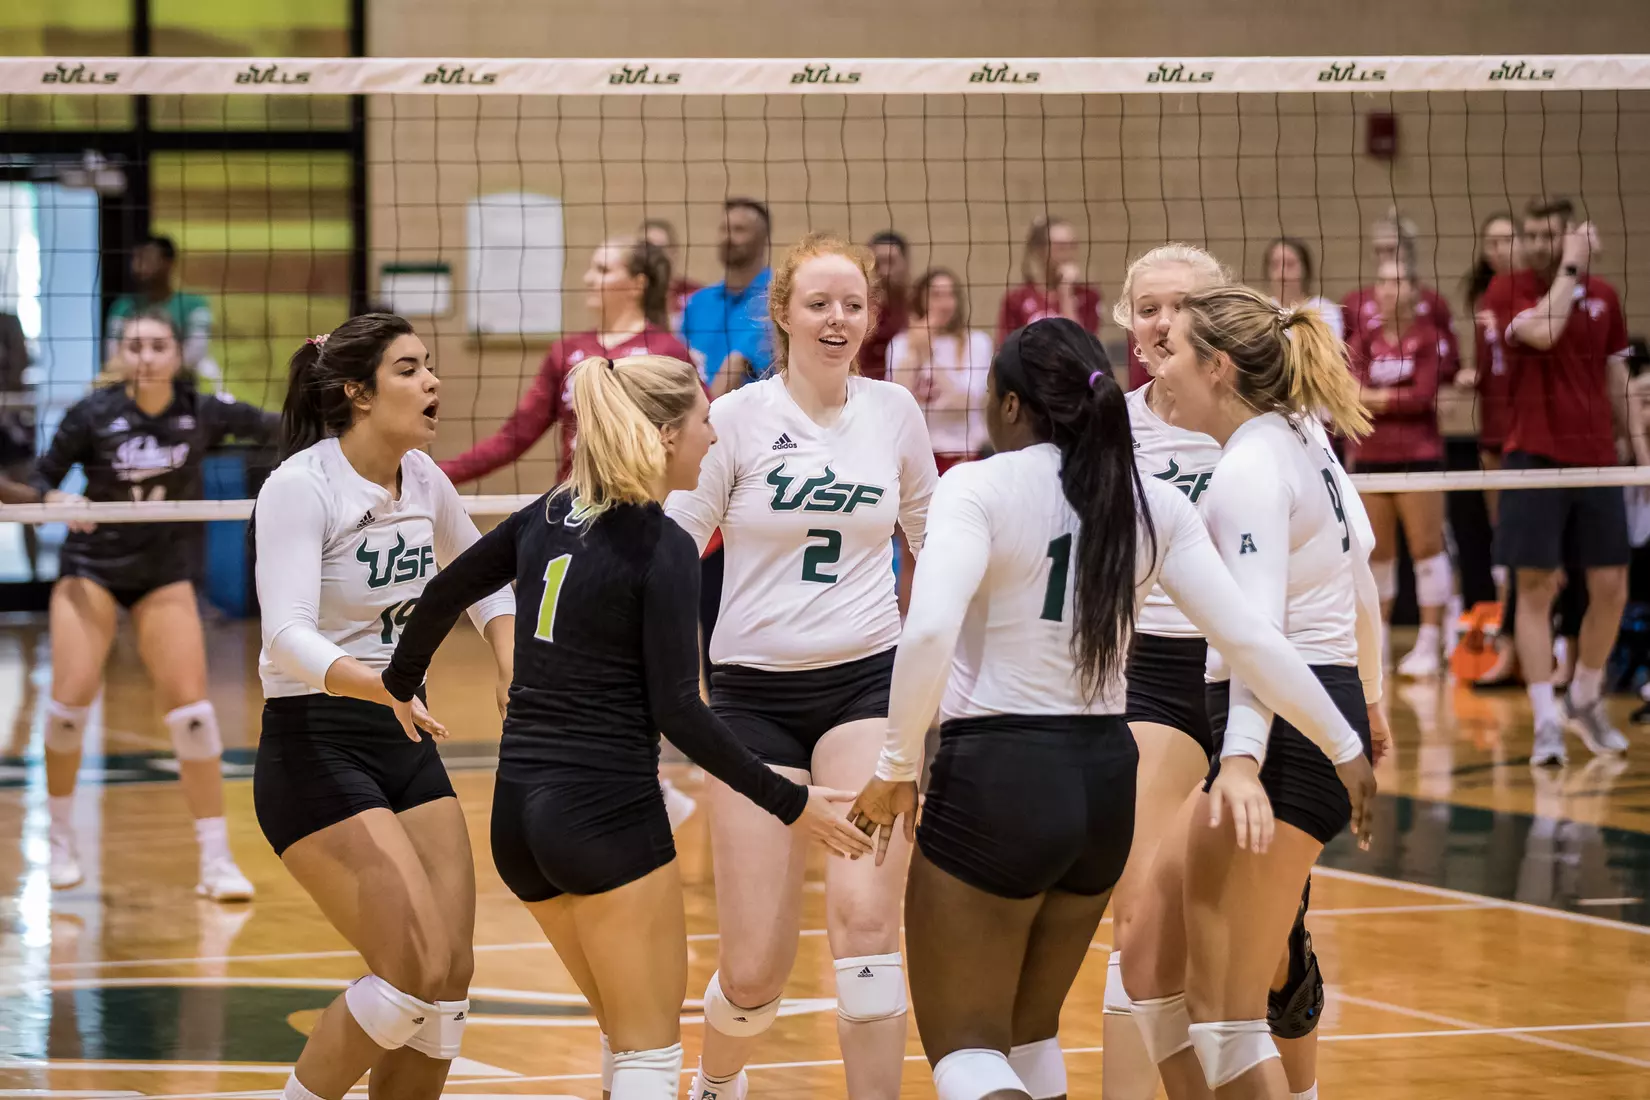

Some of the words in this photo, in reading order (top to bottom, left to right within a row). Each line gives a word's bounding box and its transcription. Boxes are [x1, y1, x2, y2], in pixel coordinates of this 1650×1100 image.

[41, 63, 119, 85] BULLS
[235, 63, 311, 85] BULLS
[423, 64, 497, 85] BULLS
[609, 63, 680, 85] BULLS
[790, 63, 861, 84] BULLS
[969, 62, 1040, 83] BULLS
[1146, 62, 1214, 83] BULLS
[1317, 61, 1386, 82] BULLS
[1488, 60, 1555, 81] BULLS
[771, 442, 798, 451] adidas
[765, 460, 886, 514] USF
[1238, 532, 1259, 556] A
[355, 530, 435, 589] USF
[801, 528, 843, 584] 2
[1038, 532, 1073, 623] 1
[533, 553, 574, 644] 1
